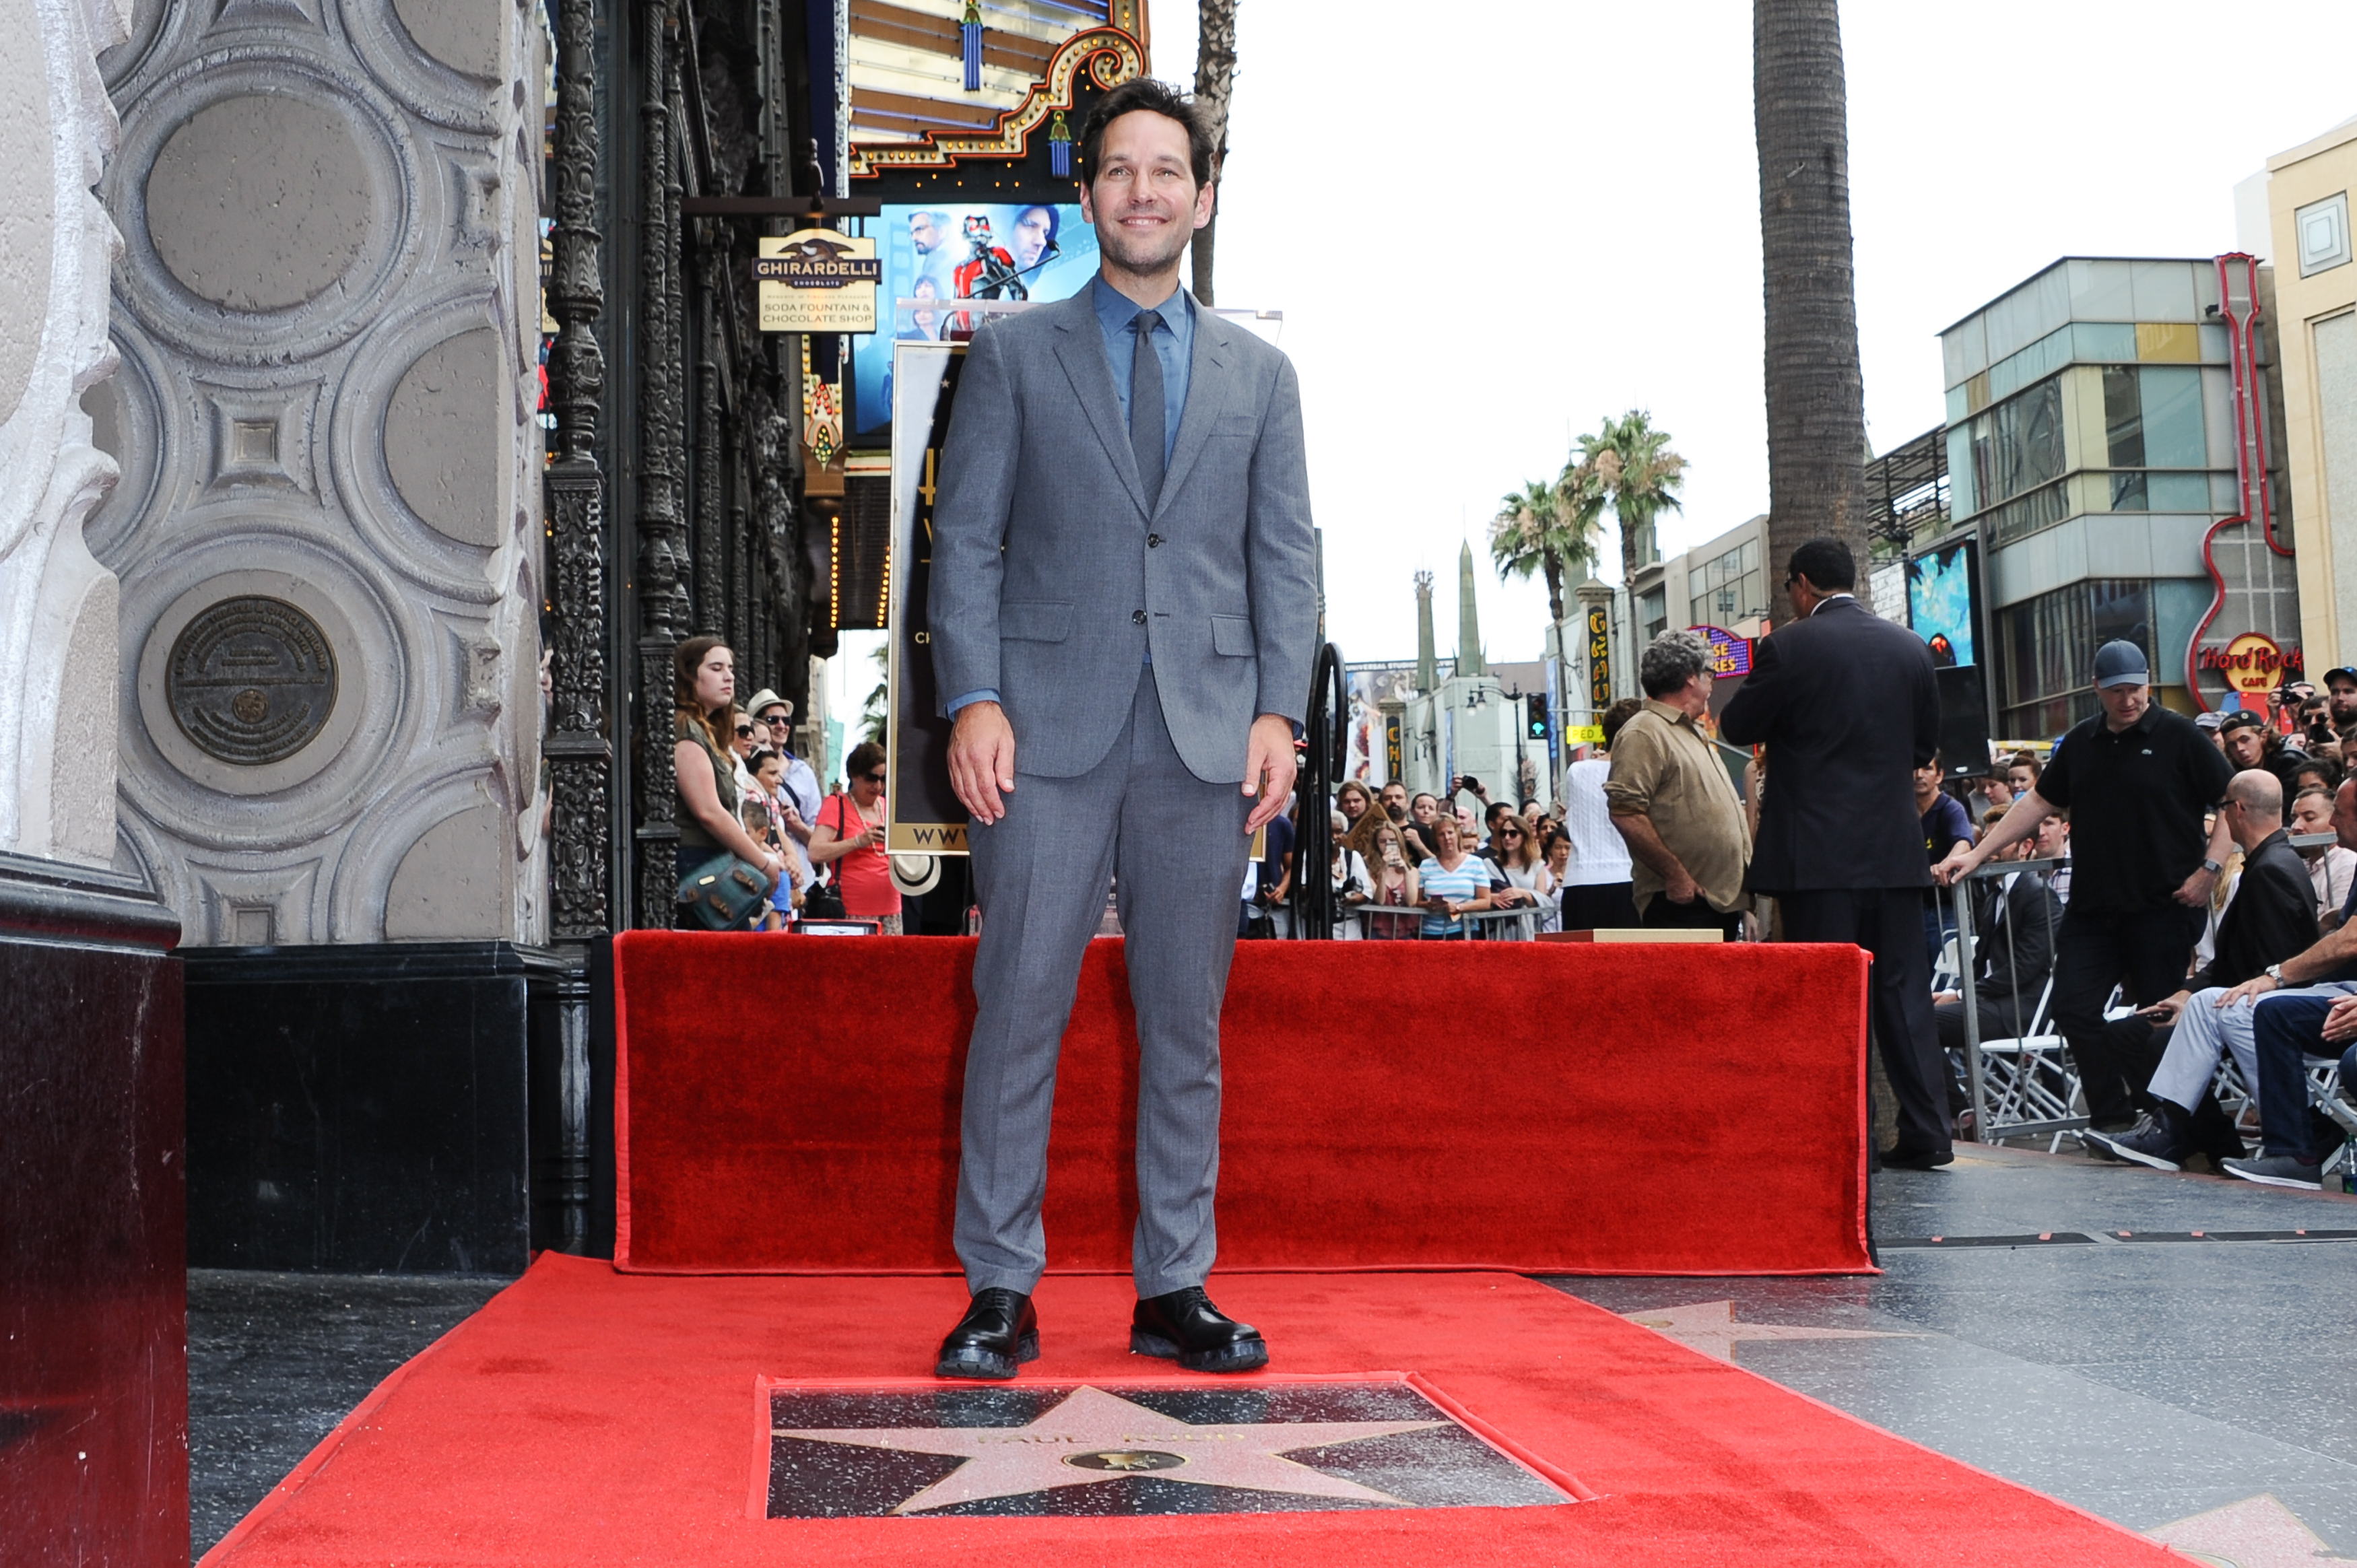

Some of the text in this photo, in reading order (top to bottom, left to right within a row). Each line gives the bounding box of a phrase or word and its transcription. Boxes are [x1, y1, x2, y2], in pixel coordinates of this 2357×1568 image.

[758, 262, 877, 275] GHIRARDELLI
[764, 304, 871, 312] SODA FOUNTAIN &
[763, 314, 872, 323] CHOCOLATE SHOP
[267, 604, 302, 627] OFFICE
[298, 623, 328, 671] BUILDING
[2200, 646, 2304, 674] Hard Rock
[1345, 662, 1387, 672] UNIVERSAL
[1572, 729, 1594, 740] PED
